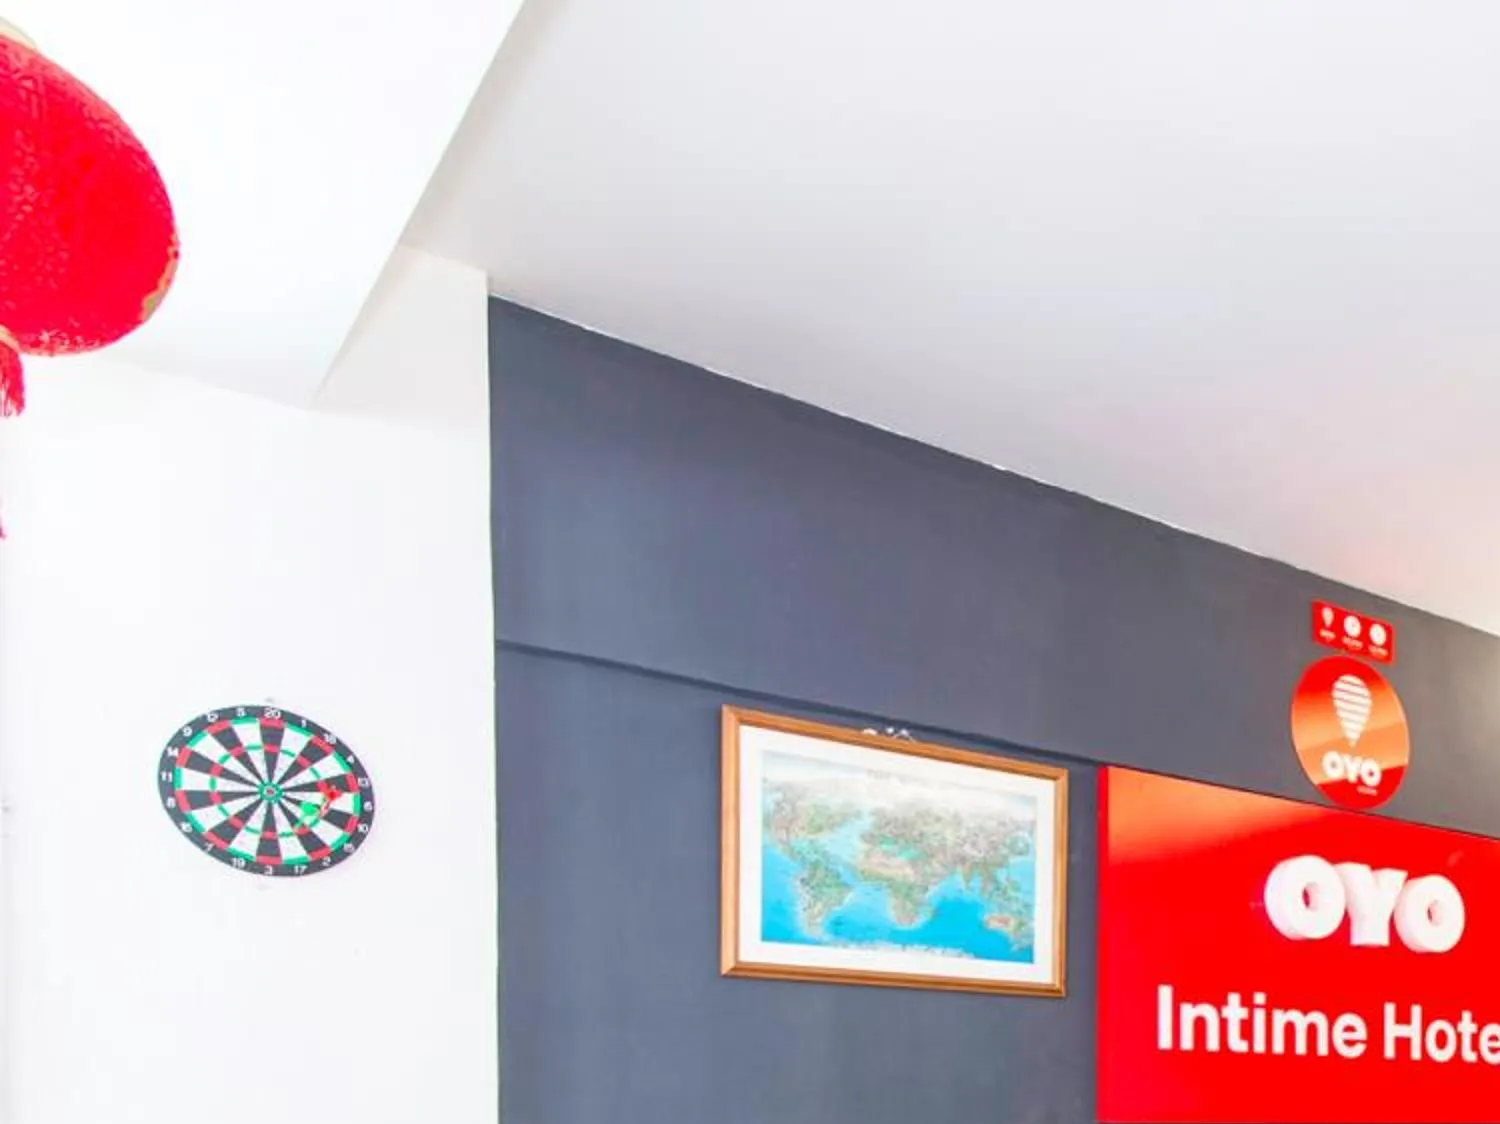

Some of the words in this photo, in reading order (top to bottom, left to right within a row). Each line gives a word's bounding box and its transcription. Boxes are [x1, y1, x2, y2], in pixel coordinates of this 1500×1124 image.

[264, 707, 281, 719] 20
[183, 726, 193, 737] 9
[161, 771, 173, 783] 11
[1321, 750, 1382, 787] OYO
[1264, 854, 1466, 954] OYO
[1157, 983, 1368, 1058] Intime
